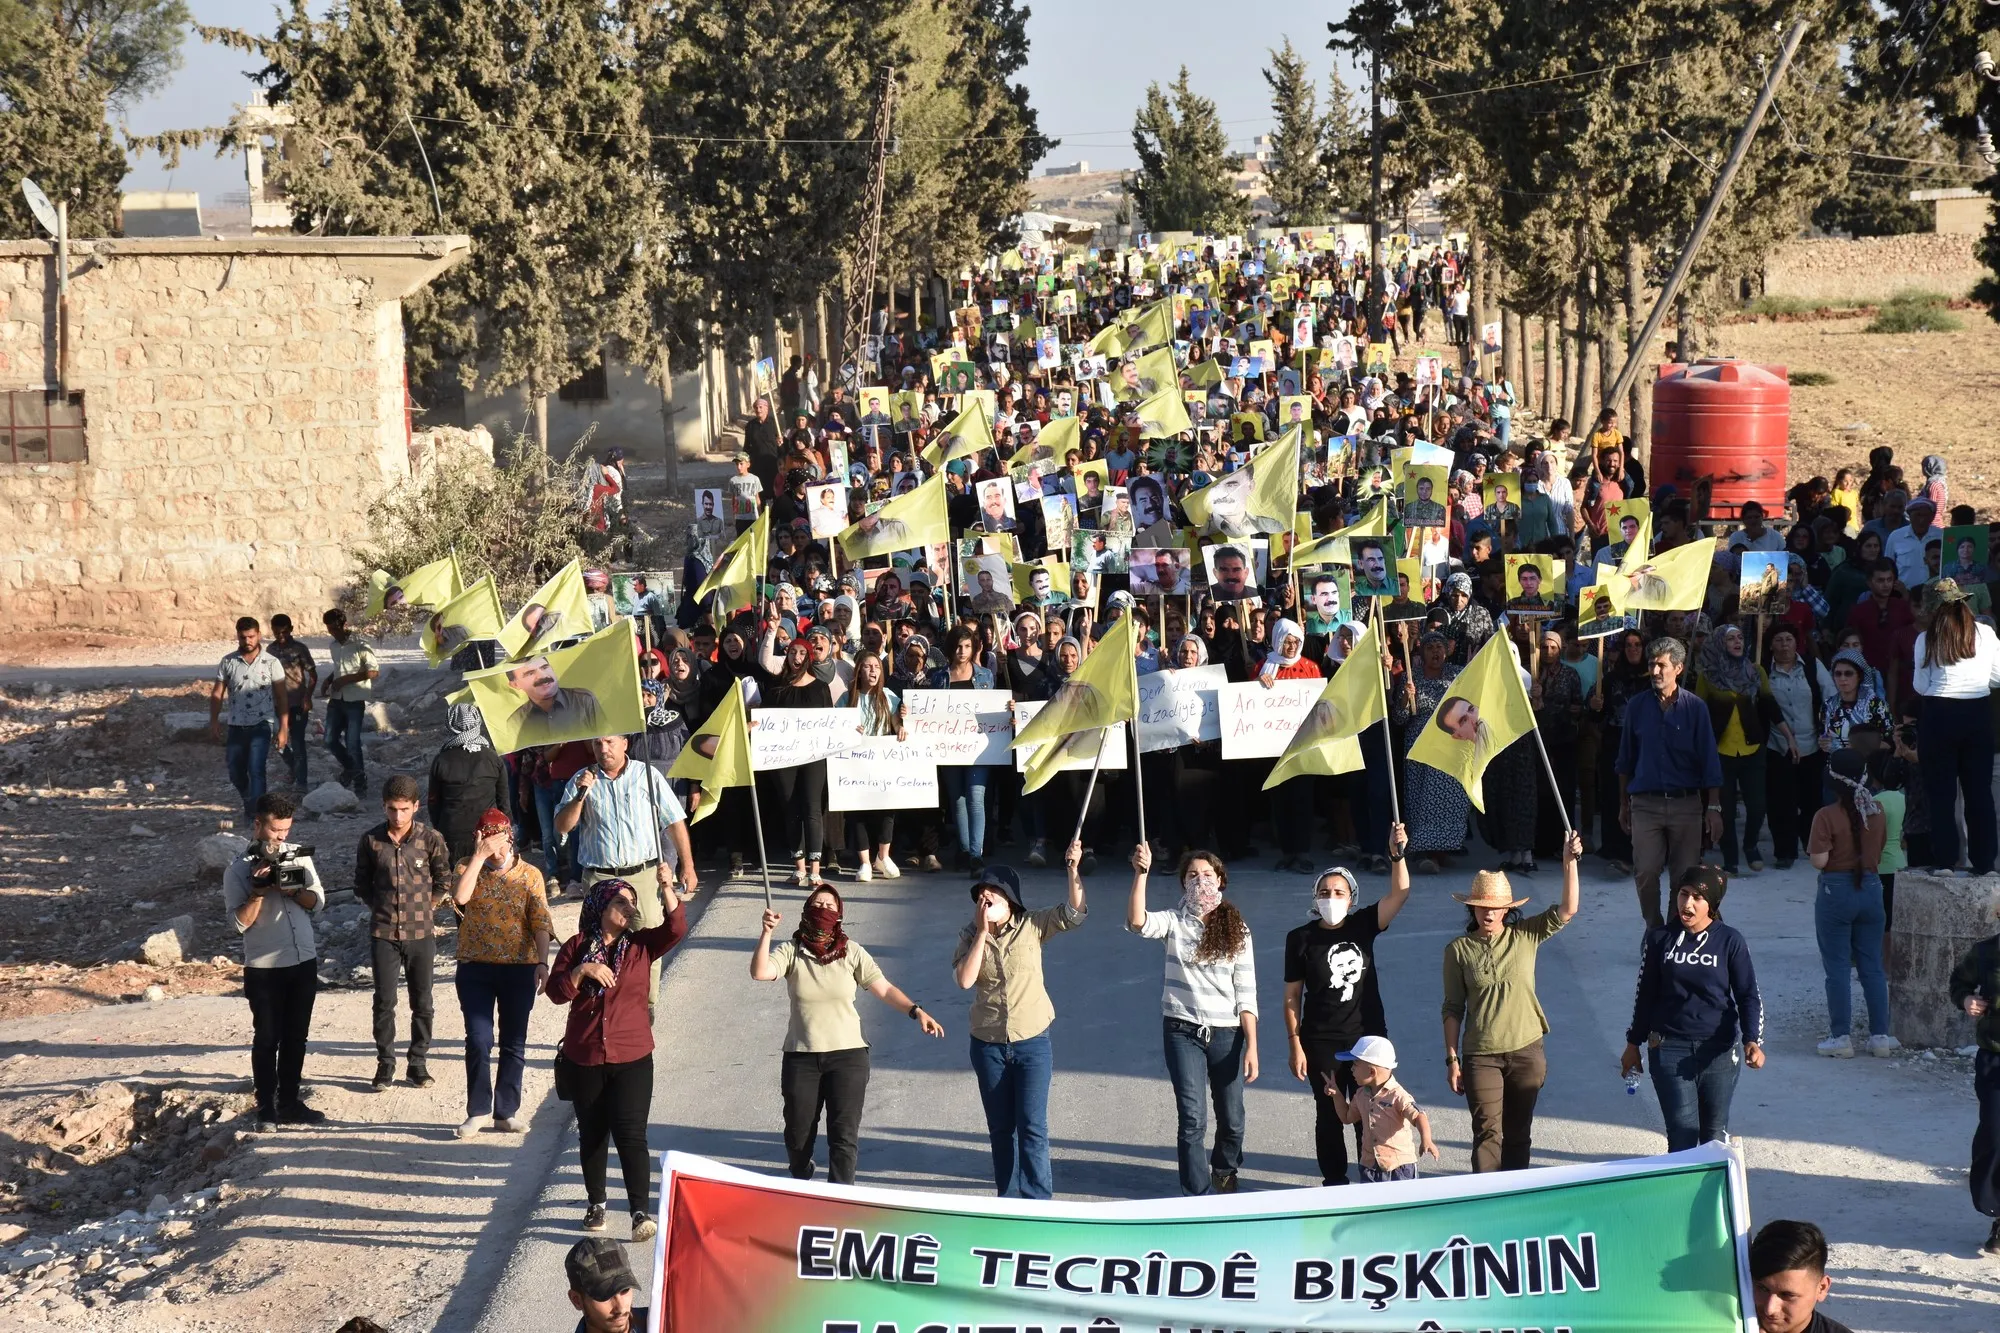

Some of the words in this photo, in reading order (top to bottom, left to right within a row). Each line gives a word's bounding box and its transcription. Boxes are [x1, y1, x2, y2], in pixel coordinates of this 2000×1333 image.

[1233, 692, 1255, 714] An
[758, 716, 776, 732] Na
[1233, 718, 1255, 737] An
[1264, 716, 1302, 732] azad
[1664, 952, 1717, 967] PUCCI
[798, 1226, 941, 1285] EMÊ
[971, 1249, 1259, 1300] TECRÎDÊ
[1293, 1232, 1599, 1311] BIŞKÎNIN
